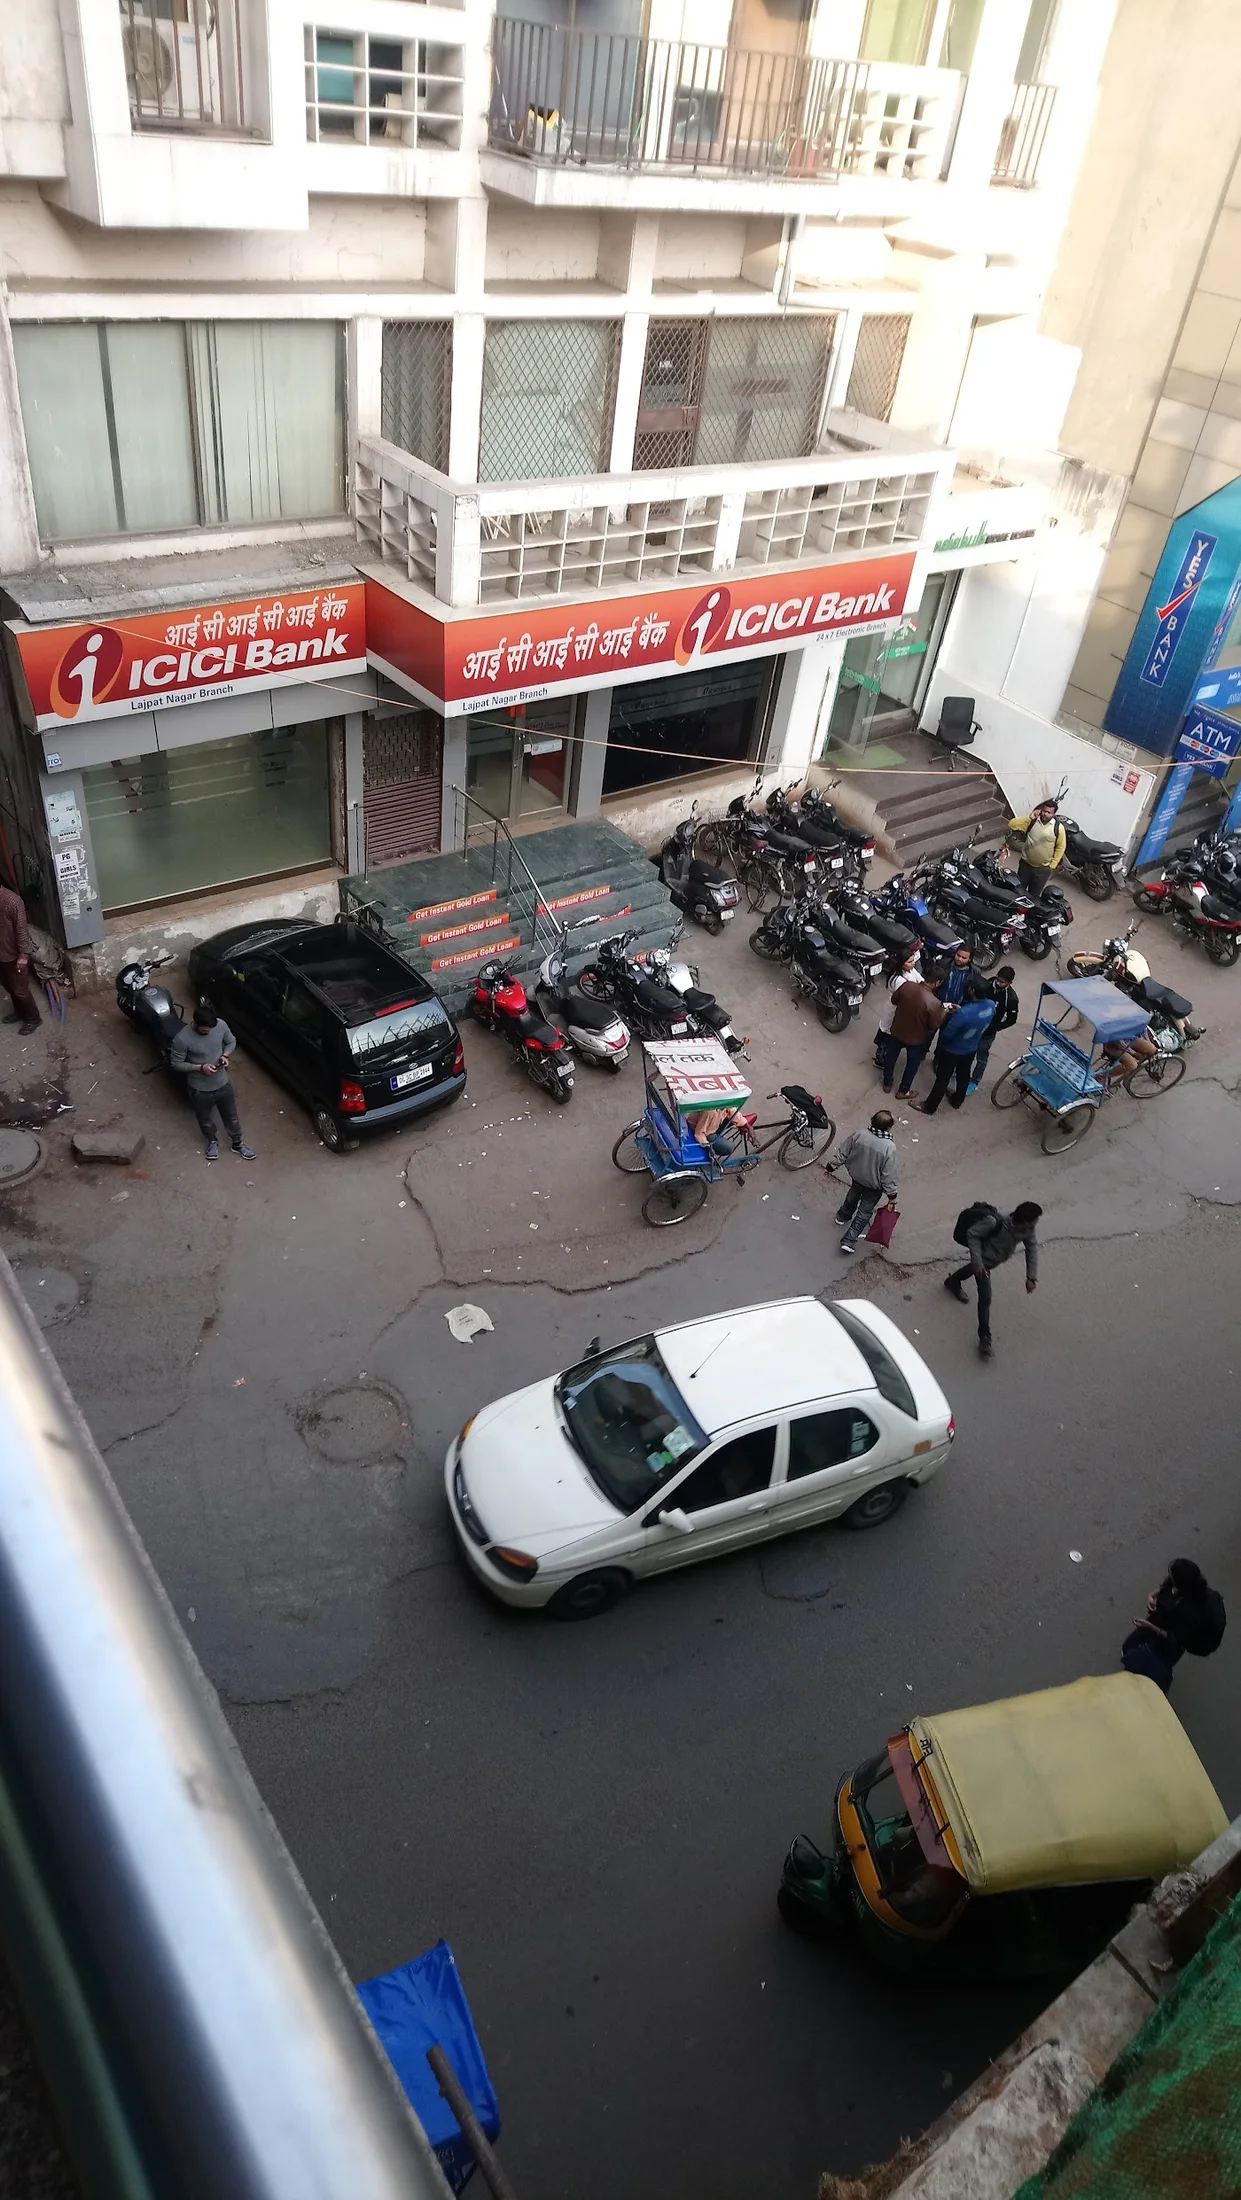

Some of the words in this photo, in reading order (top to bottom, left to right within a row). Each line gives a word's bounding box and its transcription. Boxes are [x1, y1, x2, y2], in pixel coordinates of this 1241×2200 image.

[1182, 539, 1209, 590] YES
[164, 614, 200, 647] आई
[201, 609, 225, 642] सी
[226, 604, 261, 637] आई
[262, 600, 285, 632] सी
[285, 595, 321, 629] आई
[321, 592, 349, 622] बैंक
[724, 595, 813, 641] ICICI
[812, 583, 896, 625] Bank
[835, 625, 865, 638] Electronic
[866, 621, 887, 633] Branch
[128, 644, 237, 691] ICICI
[245, 627, 350, 669] Bank
[462, 636, 507, 682] आई
[506, 632, 534, 674] सी
[532, 626, 575, 670] आई
[574, 621, 600, 662] सी
[599, 616, 641, 659] आई
[638, 612, 670, 650] बैंक
[1149, 615, 1178, 679] BANK
[130, 698, 163, 710] Lajpat
[166, 692, 197, 704] Nagar
[199, 684, 234, 698] Branch
[462, 699, 489, 711] Lajpat
[491, 693, 518, 705] Nagar
[519, 687, 548, 700] Branch
[1190, 721, 1232, 751] ATM
[60, 864, 77, 874] GIRLS
[61, 853, 71, 861] PG
[415, 909, 428, 920] Get
[429, 903, 455, 917] Instant
[456, 898, 472, 910] Gold
[473, 893, 490, 905] Loan
[556, 896, 579, 909] Instant
[580, 892, 595, 904] Gold
[596, 887, 610, 899] Loan
[427, 933, 441, 944] Get
[442, 926, 467, 940] Instant
[468, 921, 484, 933] Gold
[485, 917, 502, 929] Loan
[439, 957, 453, 968] Get
[453, 951, 479, 965] Instant
[480, 945, 496, 957] Gold
[497, 941, 514, 953] Loan
[677, 1053, 715, 1063] तक
